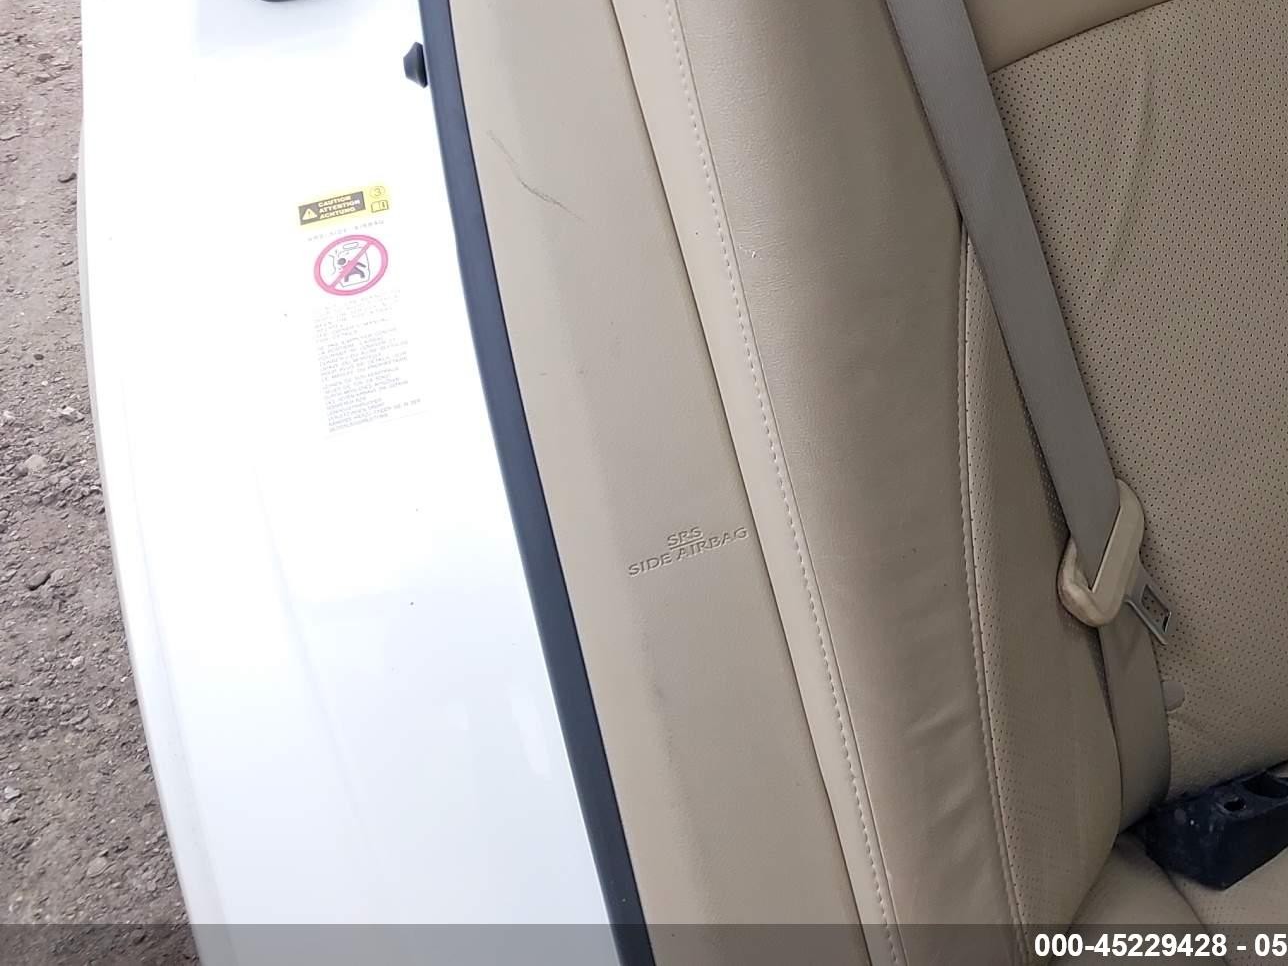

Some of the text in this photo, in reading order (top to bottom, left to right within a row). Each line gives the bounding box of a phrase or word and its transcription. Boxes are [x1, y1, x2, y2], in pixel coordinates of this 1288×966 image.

[318, 195, 352, 208] CAUTION
[319, 199, 361, 214] ATTENTION
[319, 207, 356, 220] ACHTUNG
[667, 526, 702, 547] SRS
[628, 526, 748, 576] SIDE AIRBAG
